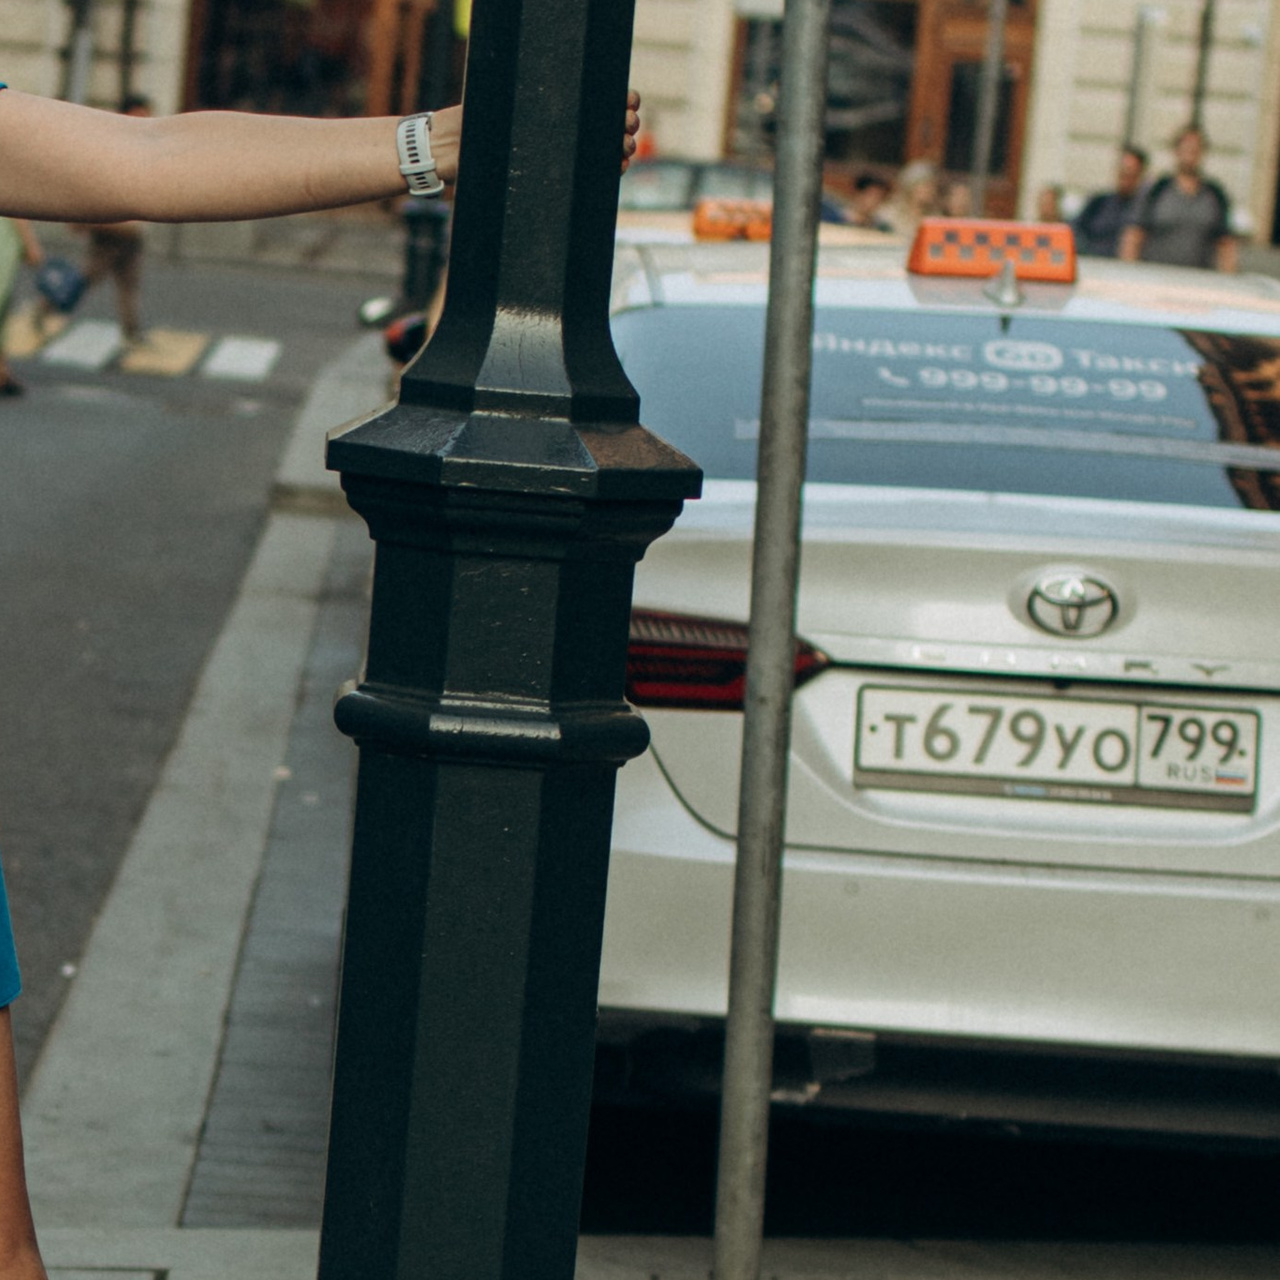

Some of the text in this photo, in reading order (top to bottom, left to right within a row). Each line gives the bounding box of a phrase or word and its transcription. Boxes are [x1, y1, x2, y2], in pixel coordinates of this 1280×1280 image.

[1072, 349, 1200, 376] Такси
[919, 365, 1167, 401] 999-99-99
[1146, 714, 1240, 765] 799
[1166, 761, 1212, 783] RUS
